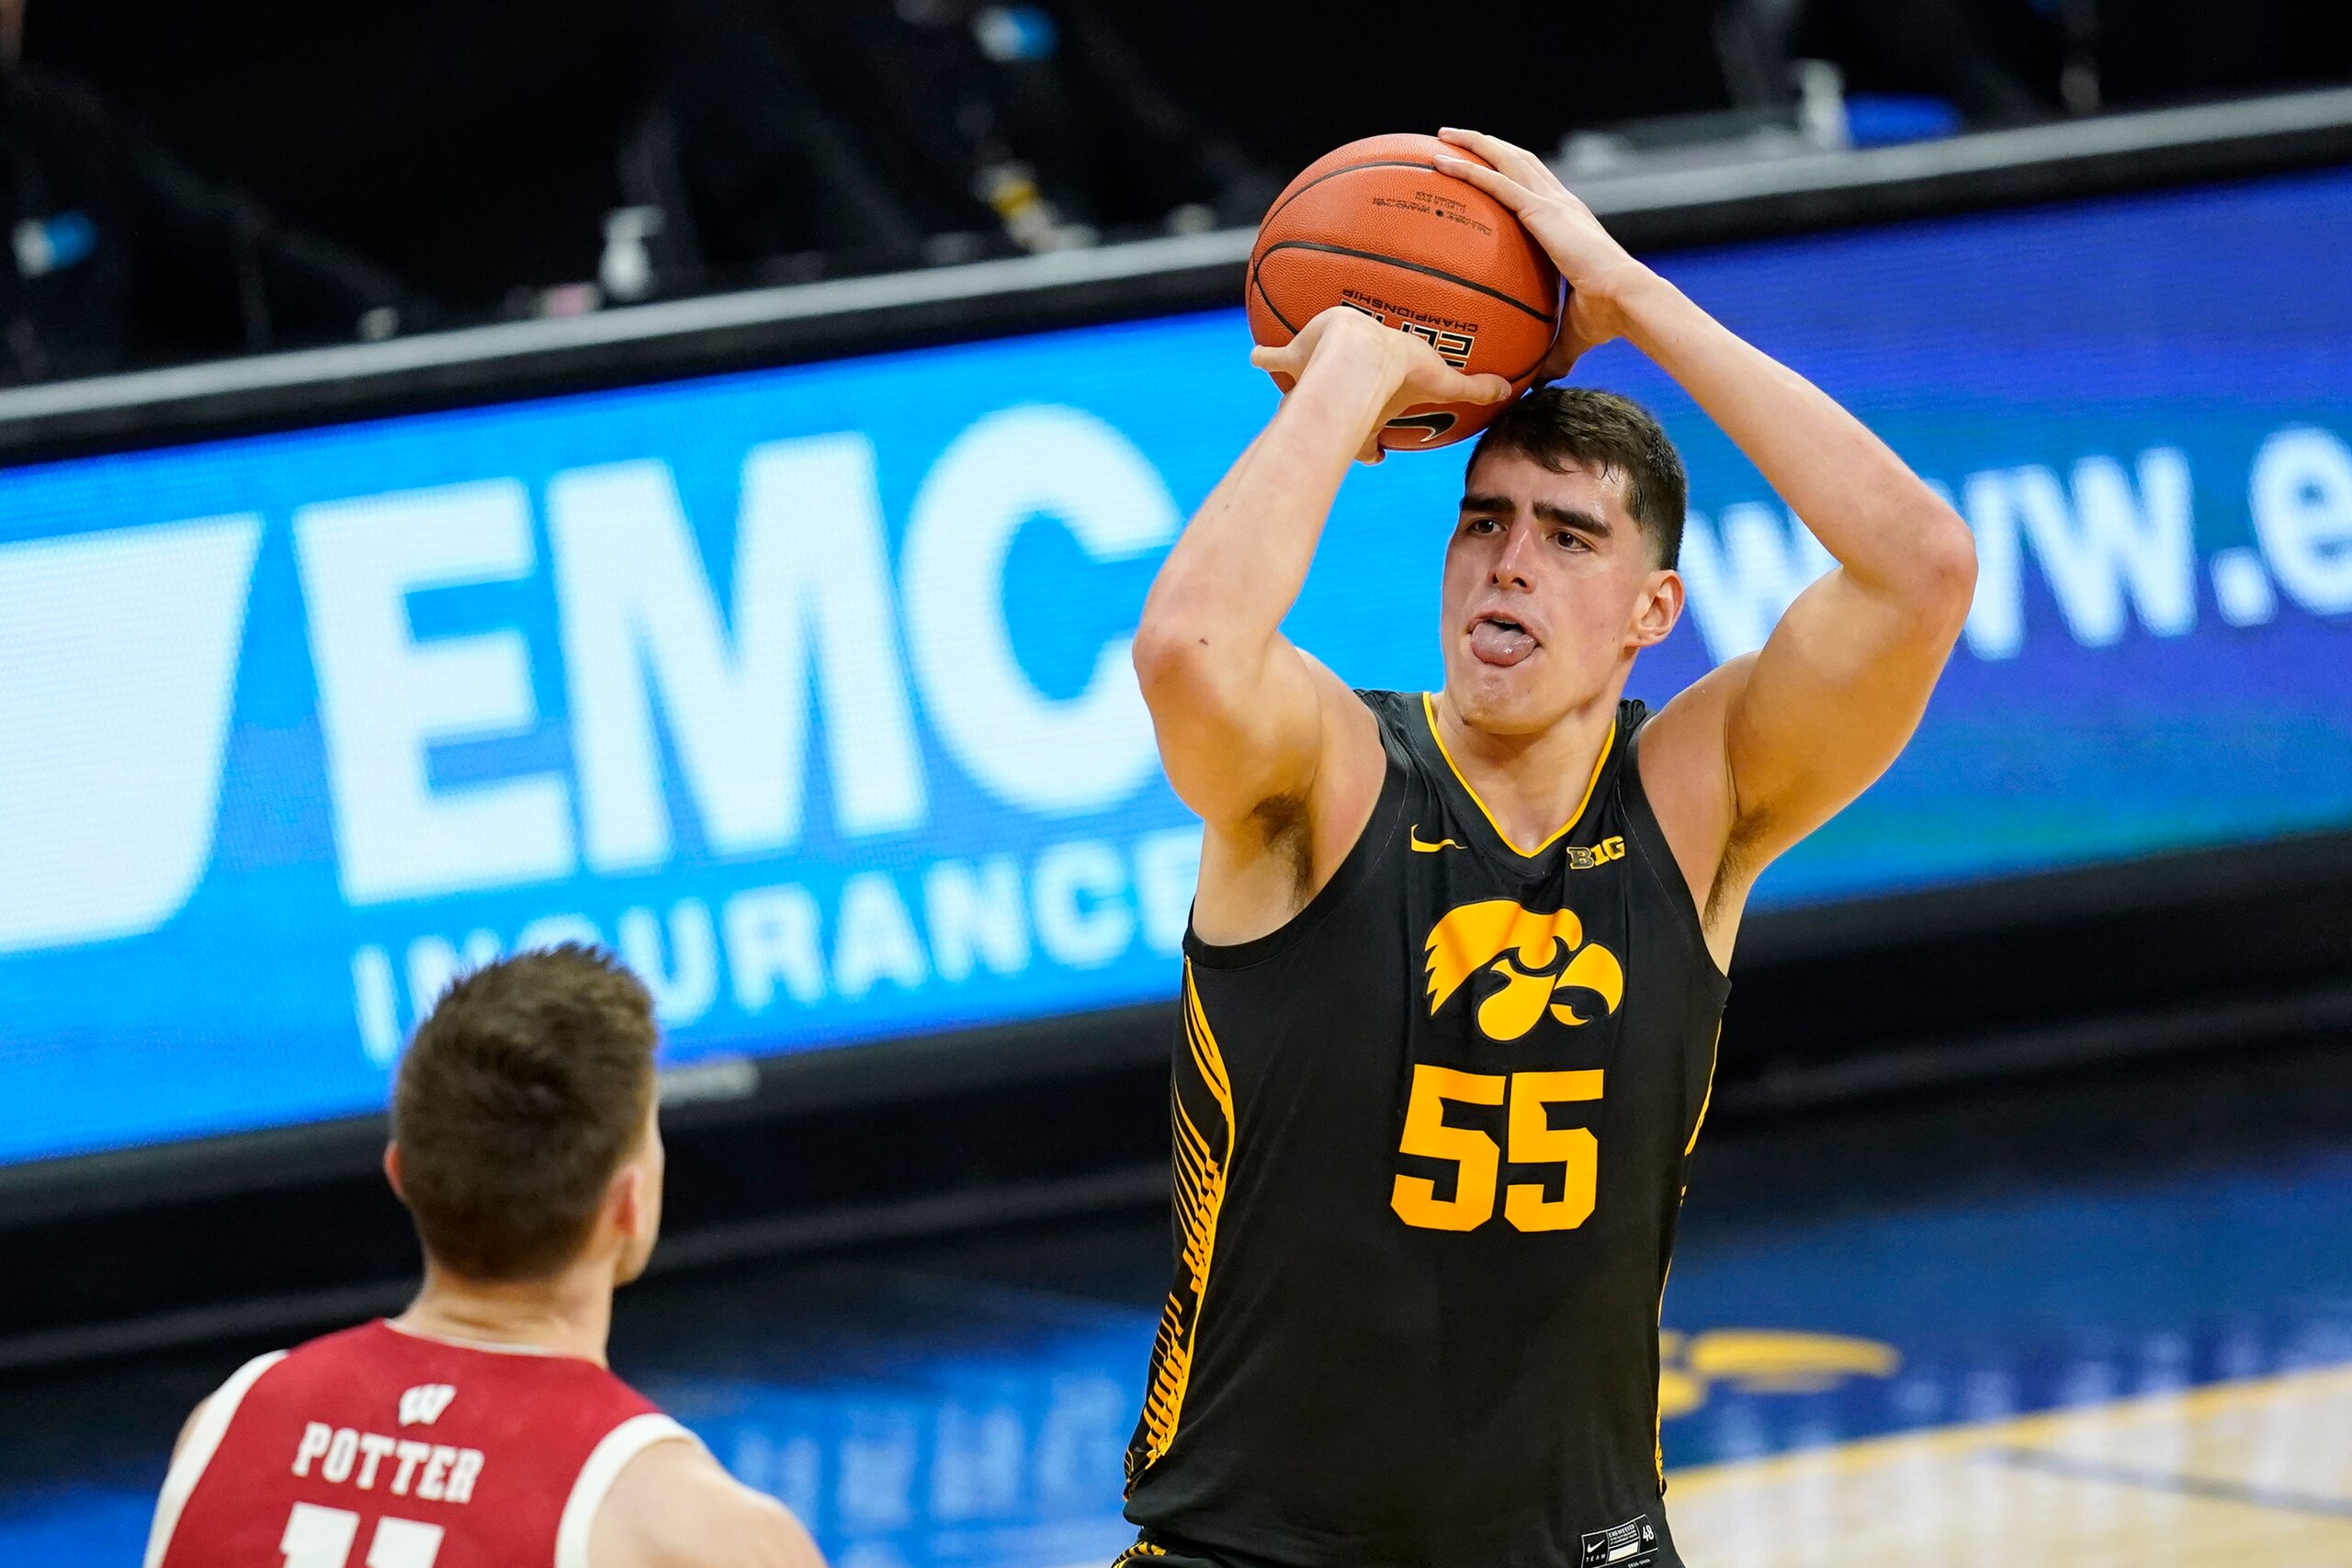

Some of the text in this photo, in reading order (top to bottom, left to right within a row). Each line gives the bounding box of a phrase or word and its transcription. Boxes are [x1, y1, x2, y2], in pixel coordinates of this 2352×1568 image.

[1341, 288, 1478, 333] CHAMPIONSHIP
[291, 402, 1189, 908] EMC
[349, 823, 1205, 1069] IURANCE
[1390, 1064, 1604, 1232] 55
[291, 1420, 485, 1504] POTTER
[1586, 1553, 1606, 1562] TEAM
[1642, 1524, 1655, 1542] 48
